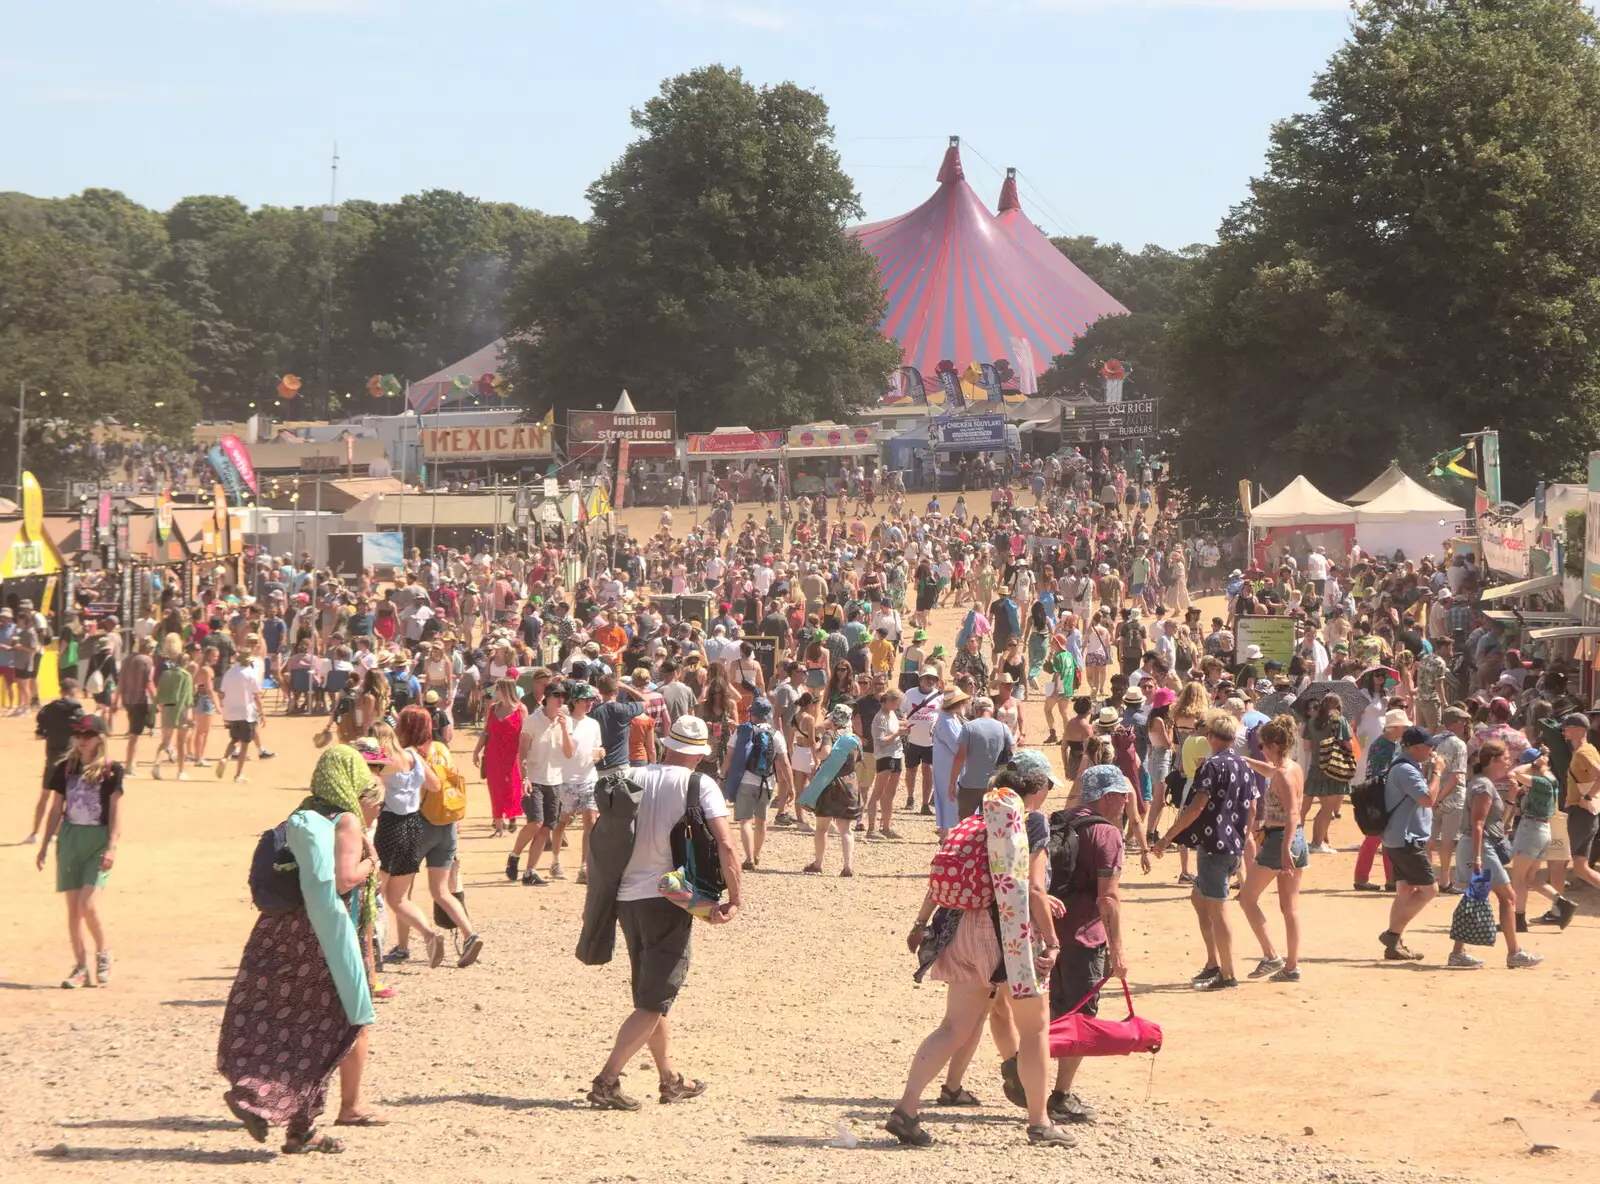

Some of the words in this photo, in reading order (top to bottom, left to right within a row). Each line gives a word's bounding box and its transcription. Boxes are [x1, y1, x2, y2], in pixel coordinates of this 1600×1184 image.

[1107, 402, 1153, 414] OSTRICH
[613, 415, 656, 426] indian
[946, 421, 972, 429] CHICKEN
[973, 419, 1001, 428] SOUVLAKI
[598, 429, 638, 439] street
[641, 429, 671, 439] food
[1119, 425, 1153, 436] BURGERS
[430, 427, 544, 452] MEXICAN
